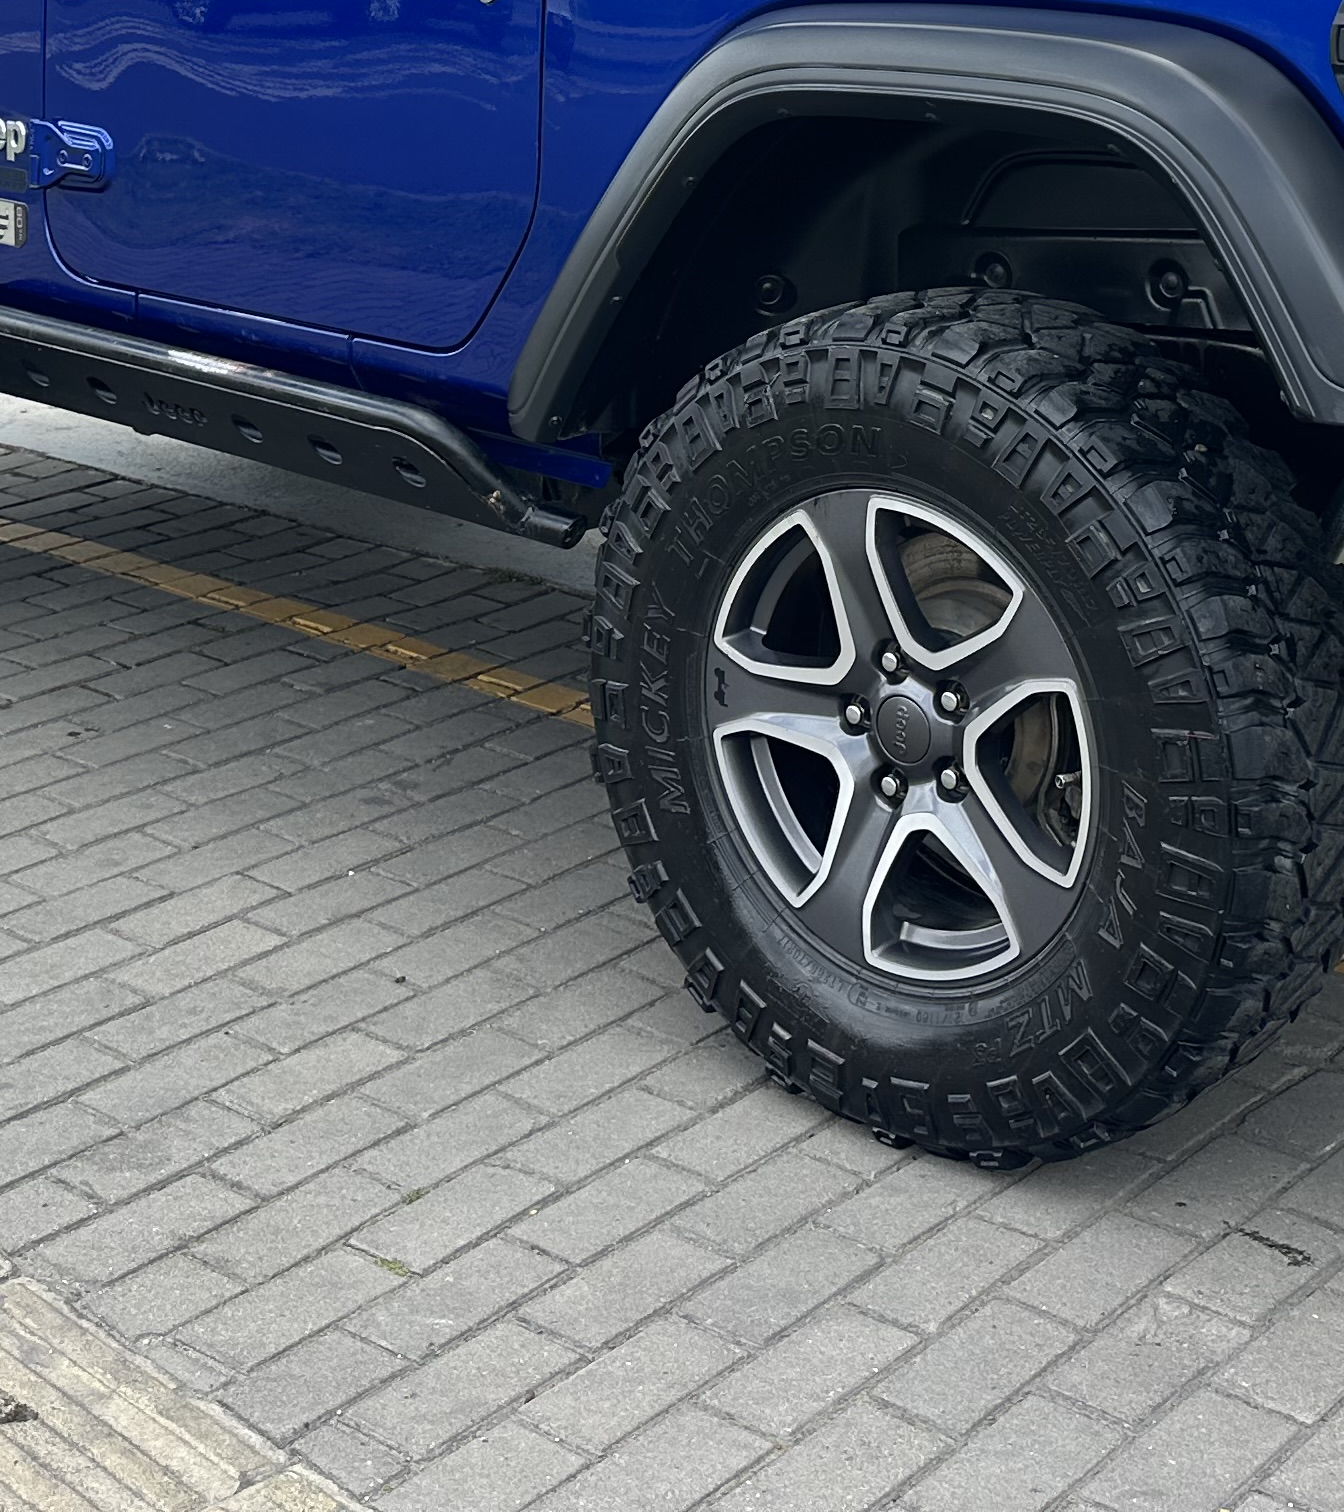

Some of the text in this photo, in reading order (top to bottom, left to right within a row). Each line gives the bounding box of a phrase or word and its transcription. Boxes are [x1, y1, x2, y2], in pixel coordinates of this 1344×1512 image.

[640, 423, 883, 815] MICKEY THOMPSON
[893, 705, 910, 755] Jeep
[1097, 780, 1148, 949] BAJA
[1006, 959, 1094, 1058] MTZ
